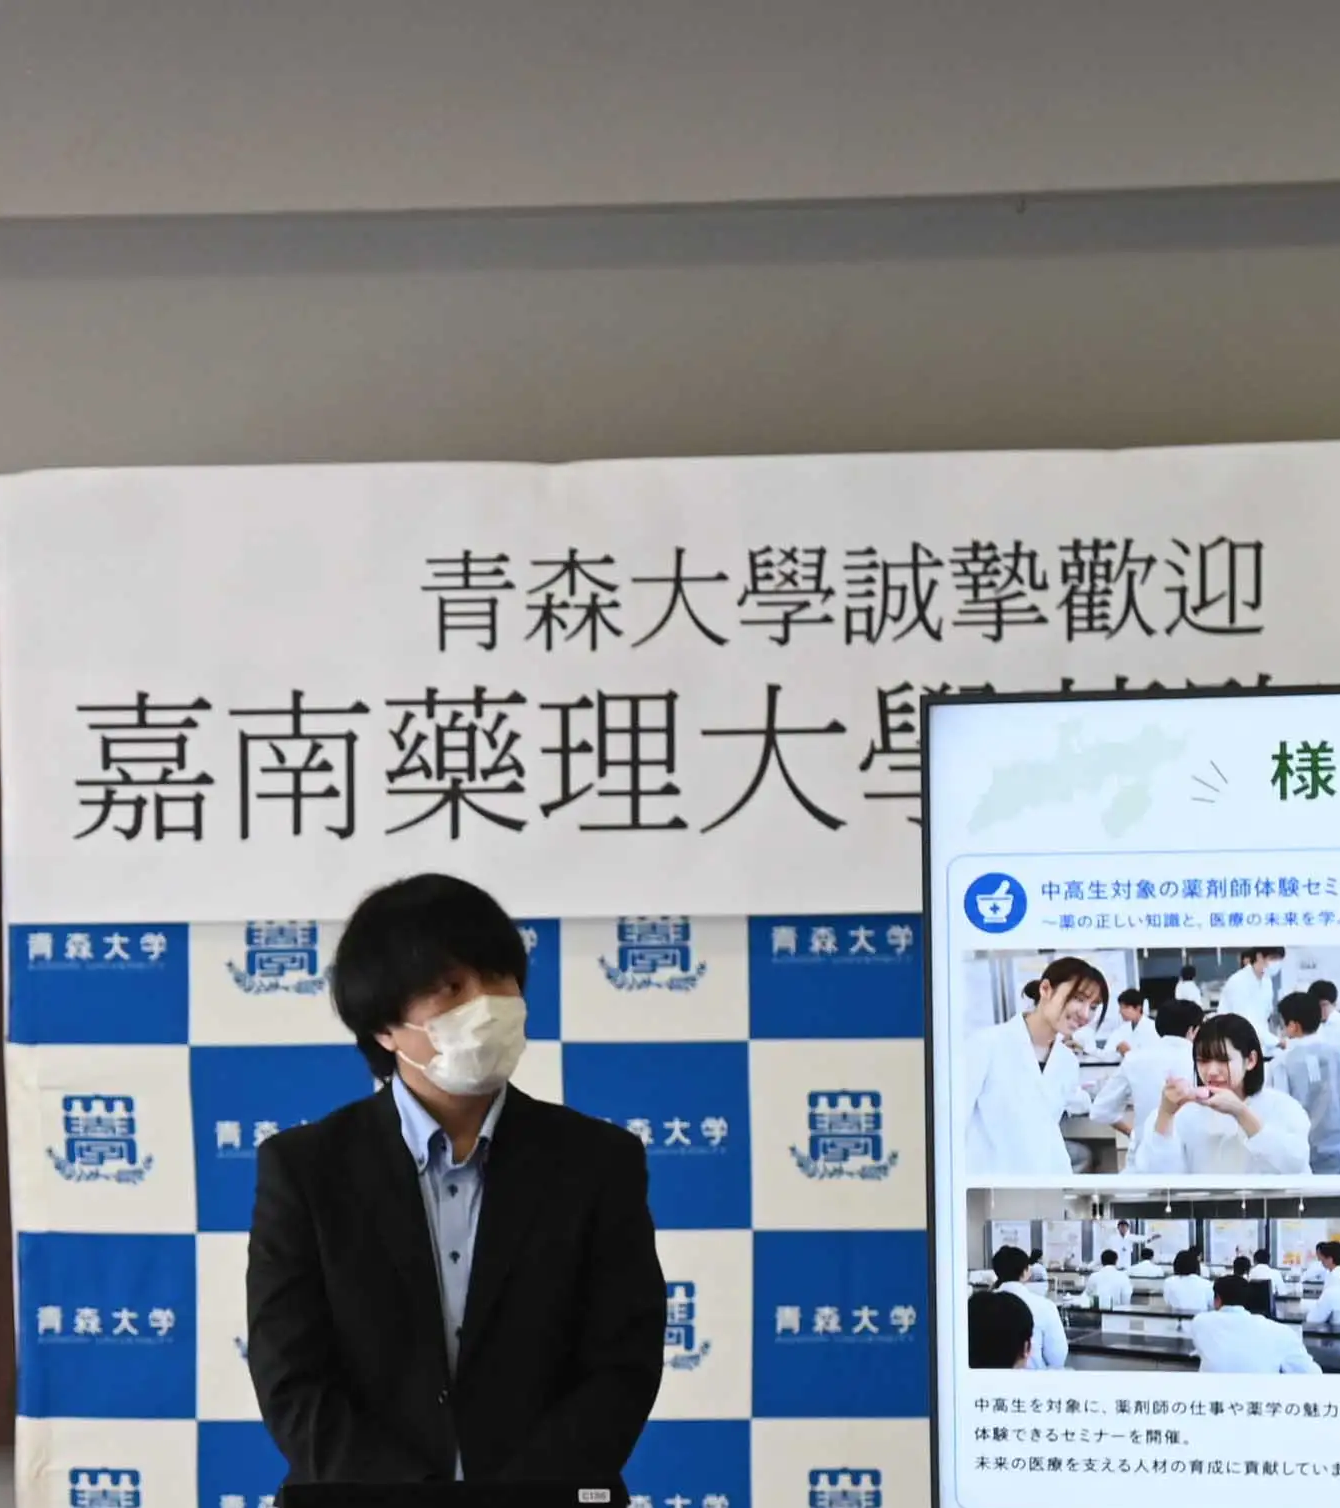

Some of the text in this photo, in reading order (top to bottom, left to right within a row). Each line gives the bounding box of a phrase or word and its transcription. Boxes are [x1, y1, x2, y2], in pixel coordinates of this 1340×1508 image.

[421, 535, 1264, 652] 青森大學誠摯歡迎
[27, 932, 167, 961] 青森大学
[771, 925, 913, 955] 青森大学
[37, 1305, 175, 1337] 青森大学
[775, 1305, 917, 1334] 青森大学
[974, 1426, 1188, 1445] 体験できるセミナーを開催。
